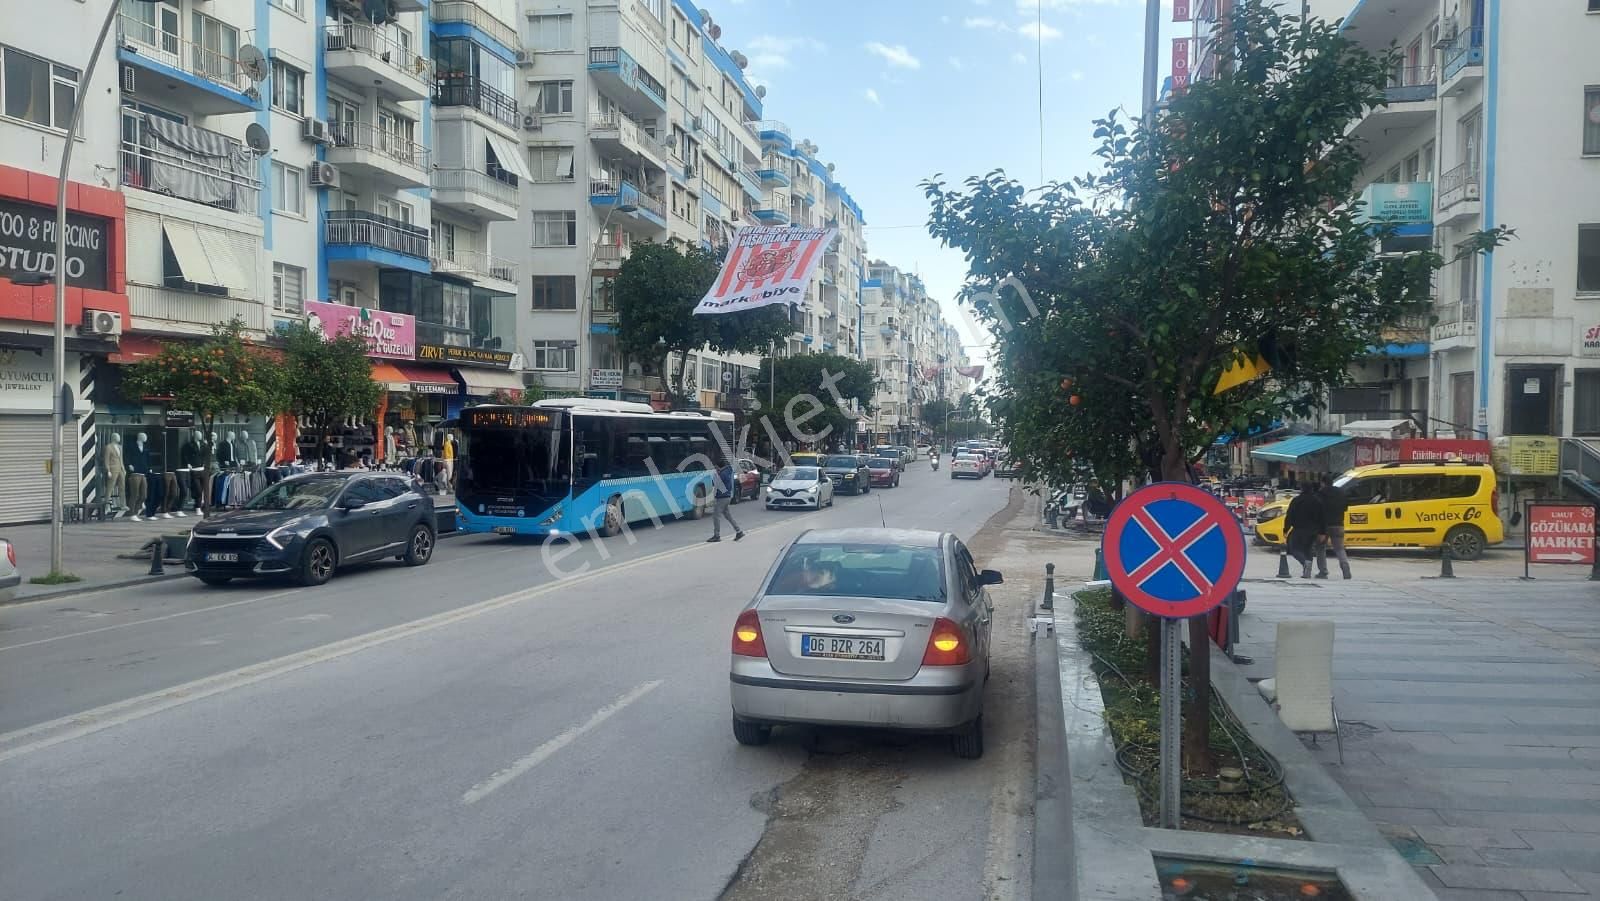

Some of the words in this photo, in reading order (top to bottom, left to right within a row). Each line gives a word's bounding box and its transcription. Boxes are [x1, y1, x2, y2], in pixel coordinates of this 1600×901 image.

[0, 212, 24, 237] OO
[28, 217, 40, 240] &
[43, 220, 100, 250] PIRCING
[0, 245, 85, 279] STUDO
[1416, 510, 1462, 522] Yandex
[1463, 507, 1482, 521] Go
[1530, 520, 1594, 533] GÖZÜKARA
[1530, 536, 1594, 548] MARKET
[810, 638, 825, 651] 06
[831, 639, 853, 653] BZR
[858, 640, 880, 655] 264
